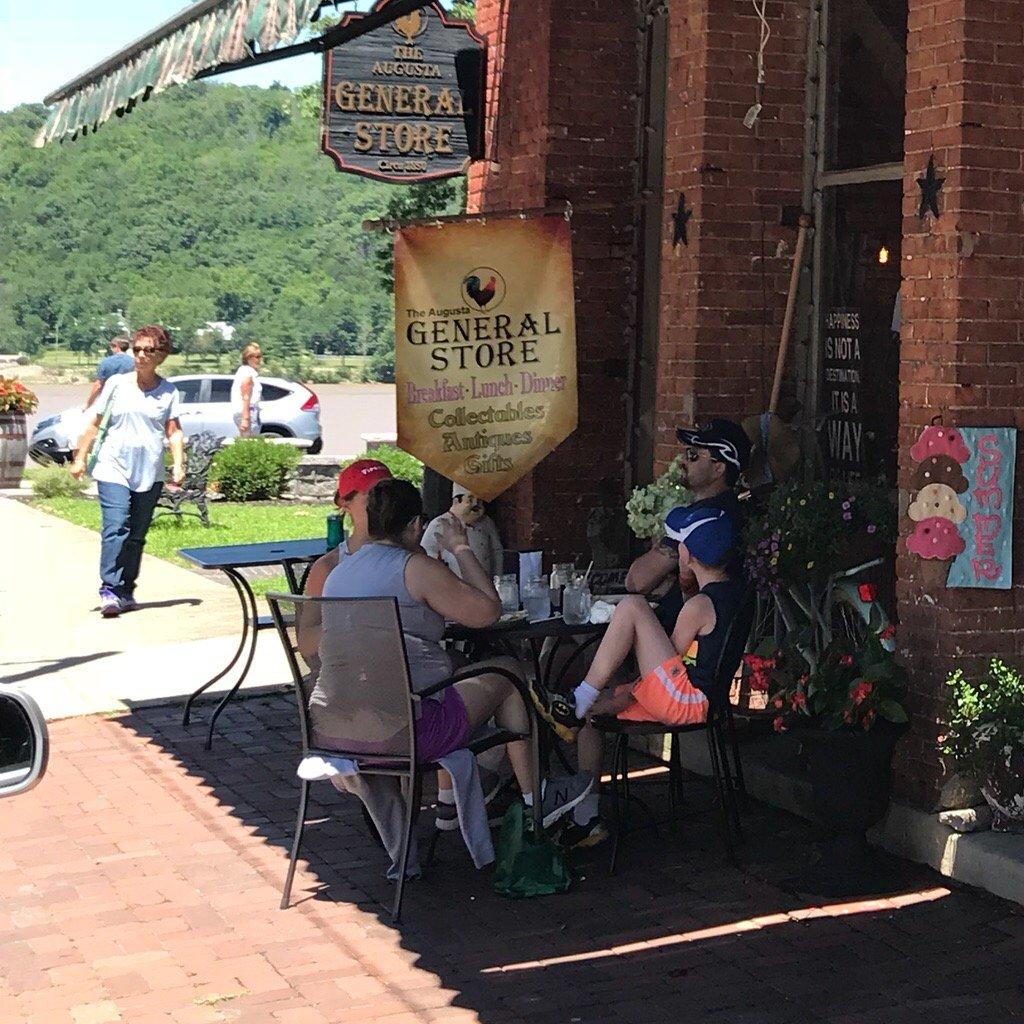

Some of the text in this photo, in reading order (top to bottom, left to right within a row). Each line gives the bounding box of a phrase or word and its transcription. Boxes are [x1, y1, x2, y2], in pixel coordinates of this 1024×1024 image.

[393, 45, 424, 61] THE
[371, 61, 442, 78] AUGUSTA
[353, 121, 453, 155] STORE
[406, 306, 471, 318] The Augusta
[825, 312, 860, 330] APPINESS
[406, 311, 562, 346] GENERAL
[430, 339, 541, 371] STORE
[834, 337, 853, 361] NOT
[853, 338, 861, 361] A
[406, 371, 567, 404] Breakfast Lunch Dinner
[831, 390, 858, 414] IT IS A
[428, 400, 546, 429] Collectables
[441, 428, 533, 453] Antiques
[827, 419, 863, 462] WAY
[464, 451, 513, 475] Gifts
